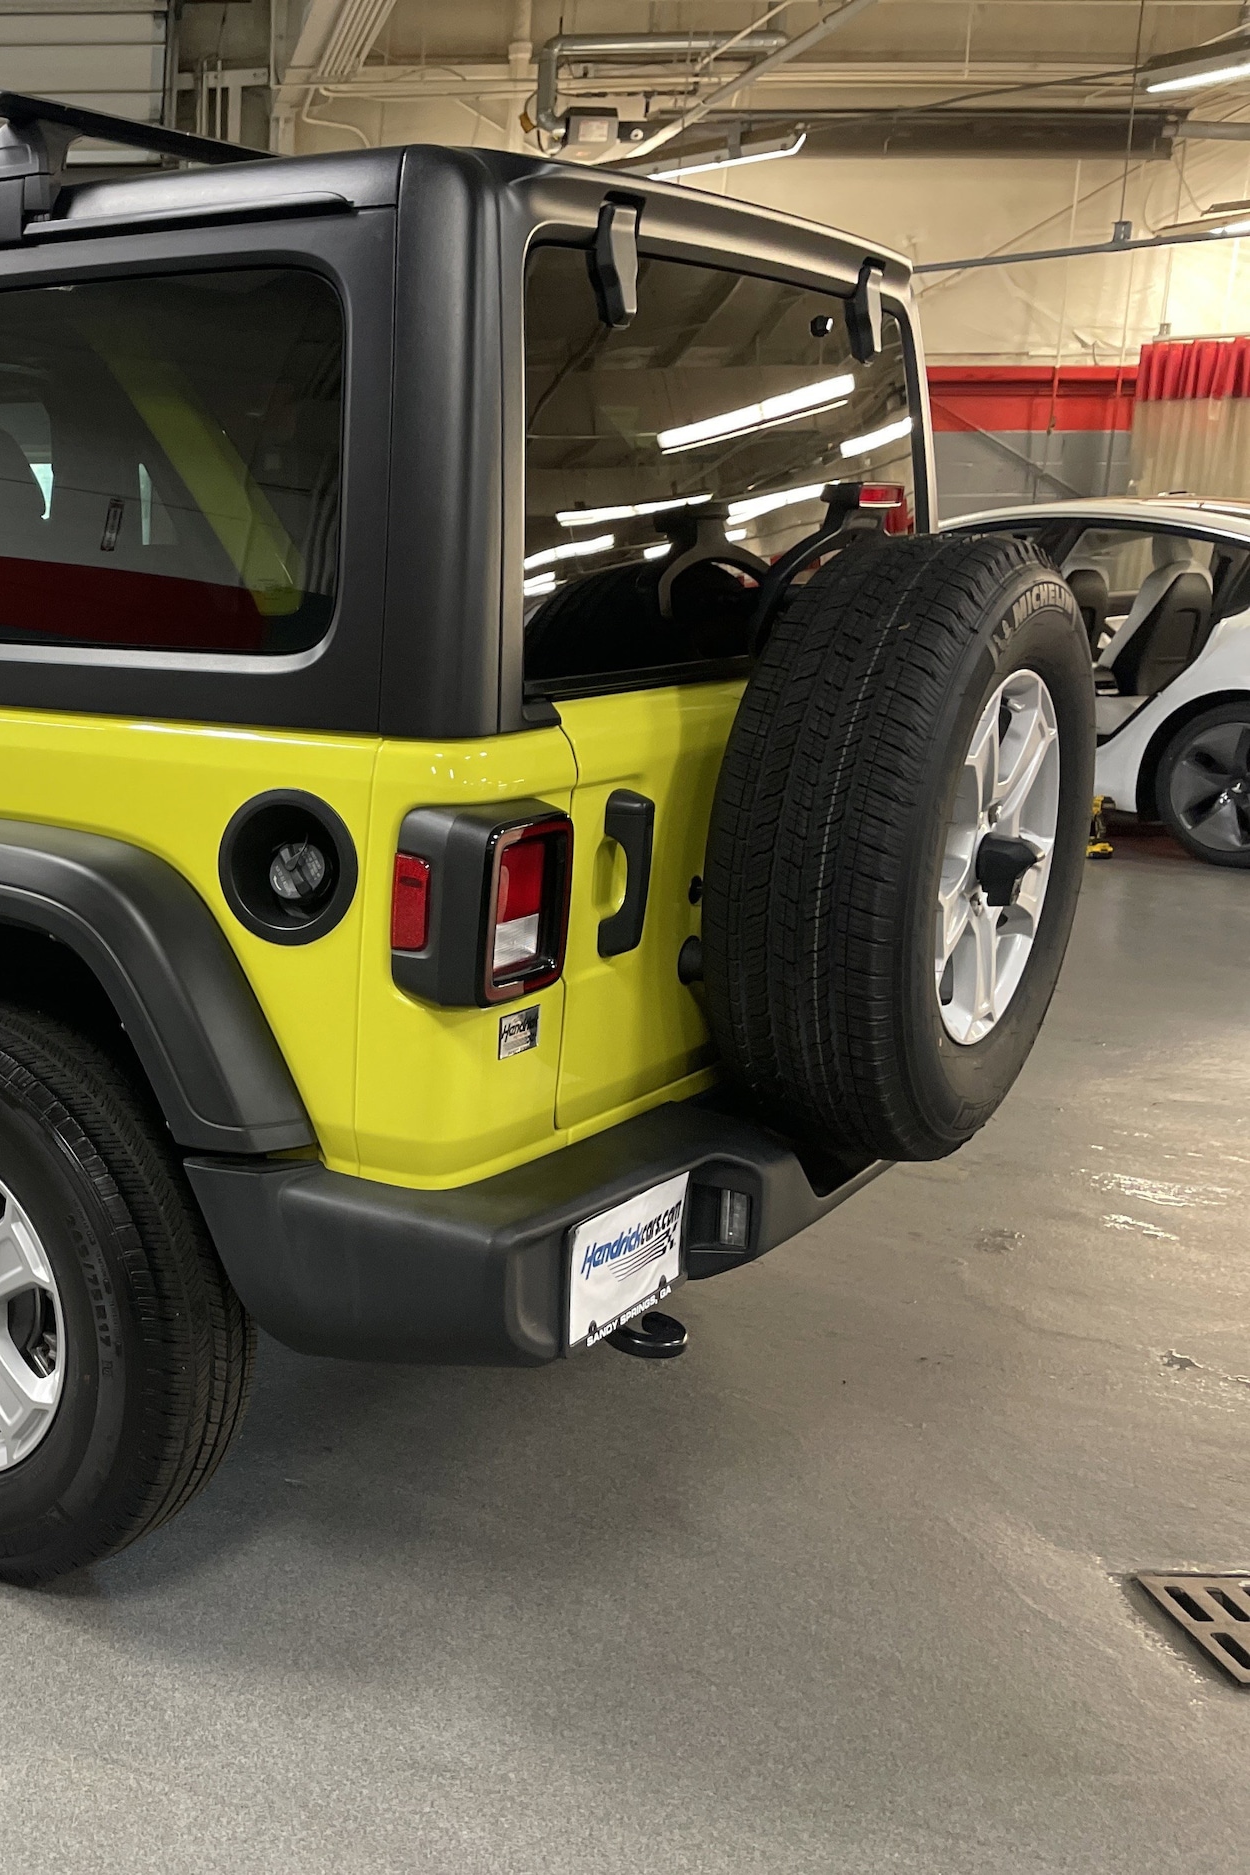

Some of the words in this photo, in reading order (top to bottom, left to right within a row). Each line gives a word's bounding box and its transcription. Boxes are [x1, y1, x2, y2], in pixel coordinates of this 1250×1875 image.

[1012, 583, 1075, 630] MICHELIN
[580, 1199, 682, 1280] Hendrickcars.com
[586, 1318, 619, 1347] SANDY
[619, 1294, 658, 1326] SPRINGS,
[659, 1285, 672, 1299] GA
